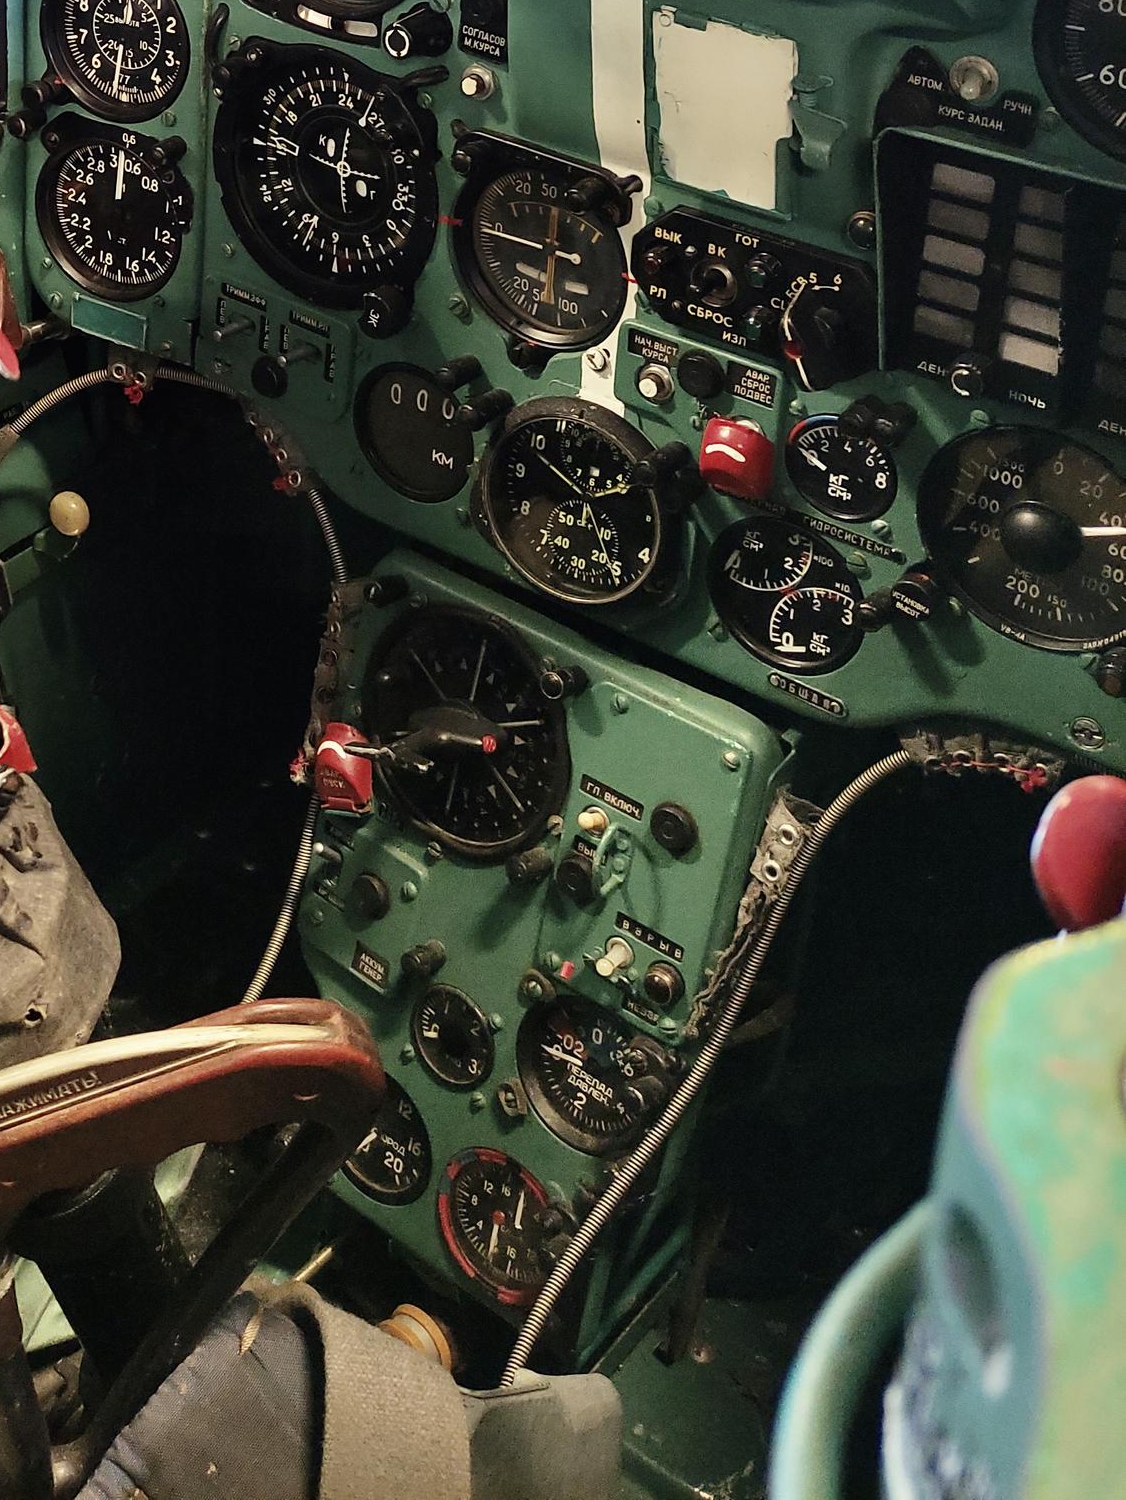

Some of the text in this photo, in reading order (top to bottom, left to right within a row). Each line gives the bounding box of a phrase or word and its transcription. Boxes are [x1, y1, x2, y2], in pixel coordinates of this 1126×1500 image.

[166, 17, 176, 33] 2
[80, 29, 88, 44] 7
[463, 25, 506, 46] СОГЛАСОВ
[92, 54, 101, 68] 6
[938, 105, 965, 121] КУРС
[735, 234, 760, 248] ГОТ
[687, 304, 733, 328] СБРОС
[723, 331, 747, 347] ИЗЛ
[642, 349, 670, 363] КУРСА
[742, 379, 771, 394] СБРОС
[1009, 389, 1047, 409] НОЧЬ
[432, 449, 454, 469] КМ
[567, 1062, 613, 1098] ПЕРЕПАД
